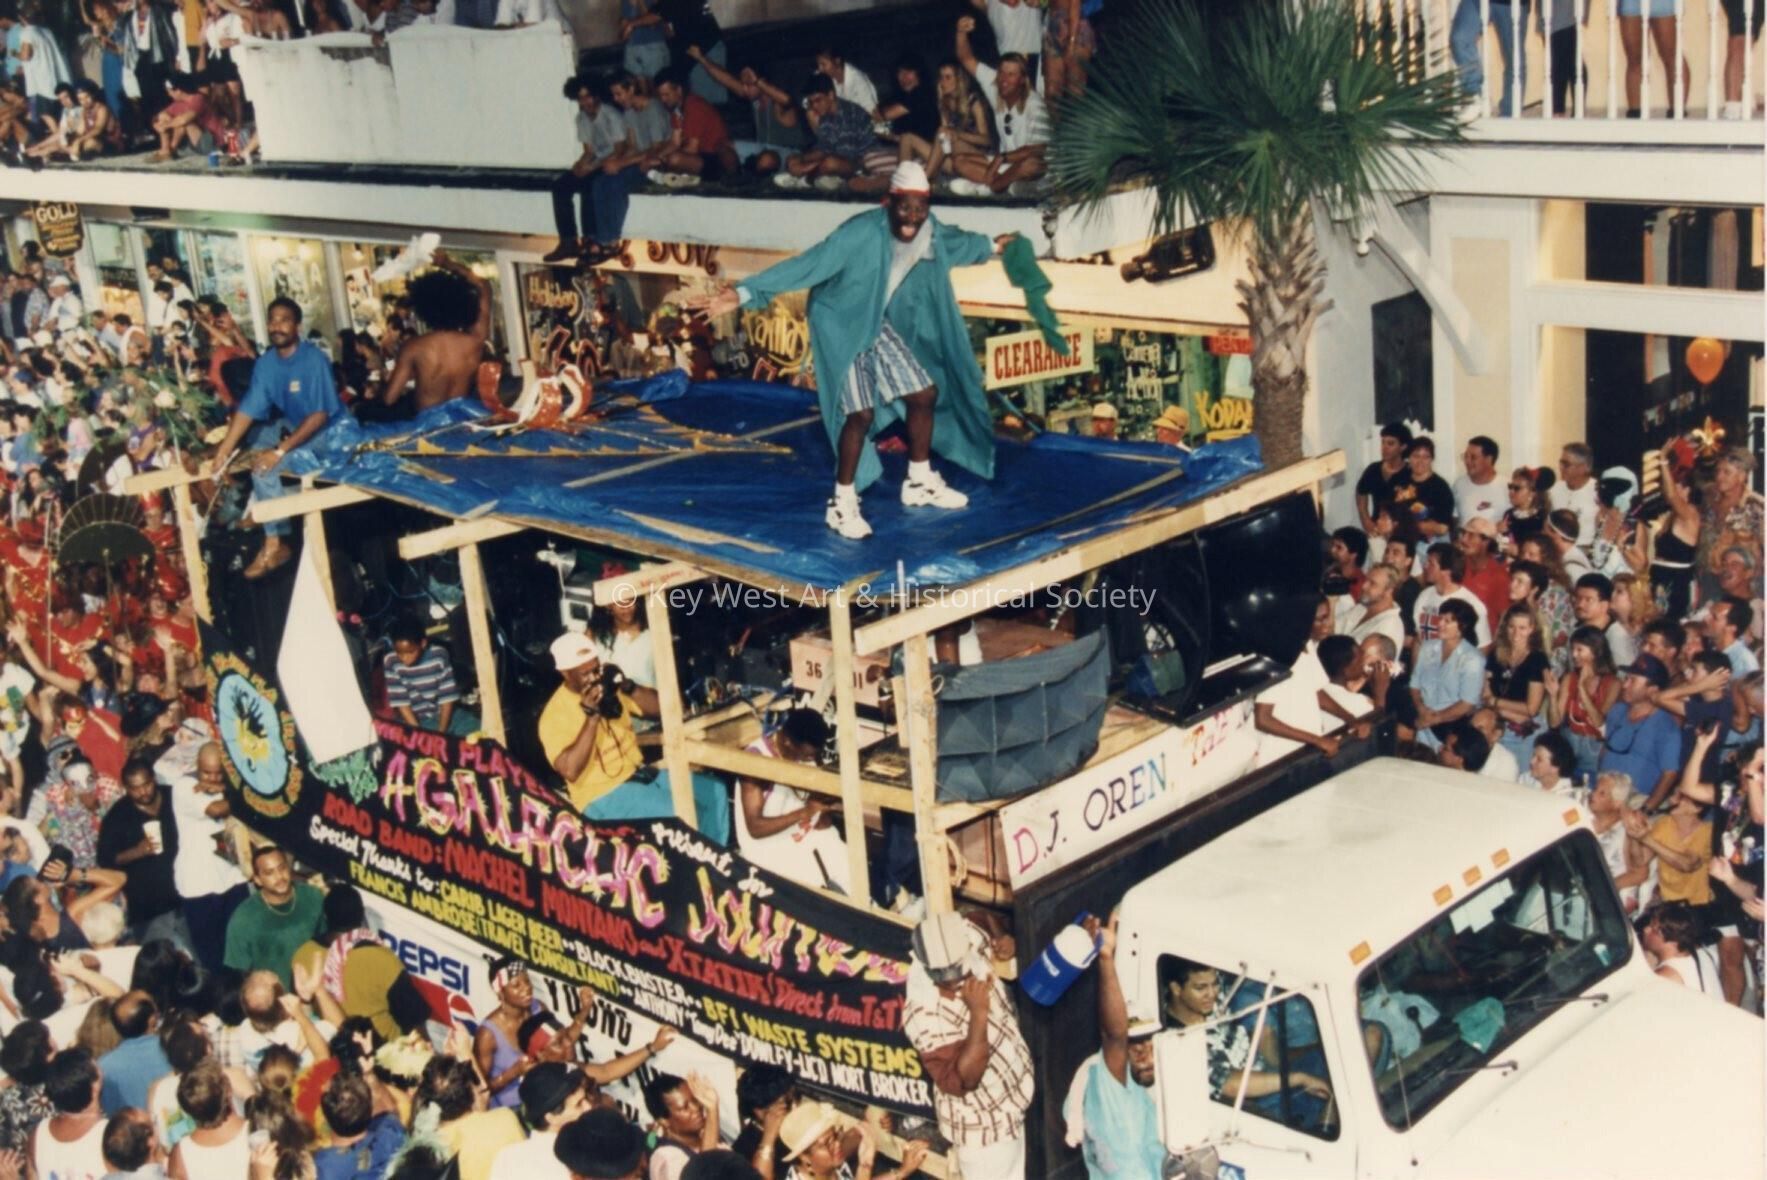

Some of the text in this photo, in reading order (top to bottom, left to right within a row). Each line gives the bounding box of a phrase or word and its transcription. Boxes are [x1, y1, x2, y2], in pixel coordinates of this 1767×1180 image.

[36, 202, 78, 224] GOLD
[374, 720, 449, 763] MAJOR
[323, 792, 373, 837] ROAD
[444, 838, 535, 909] MACHEL
[542, 880, 638, 957] MONTANO
[412, 757, 669, 928] GALACTIC
[309, 815, 359, 857] Special
[361, 840, 412, 881] Thanks
[742, 1012, 811, 1053] WASTE
[816, 1033, 922, 1078] SYSTEMS
[350, 860, 407, 903] FRANCIS
[869, 1072, 932, 1107] BROKER
[379, 929, 470, 996] PEPSI
